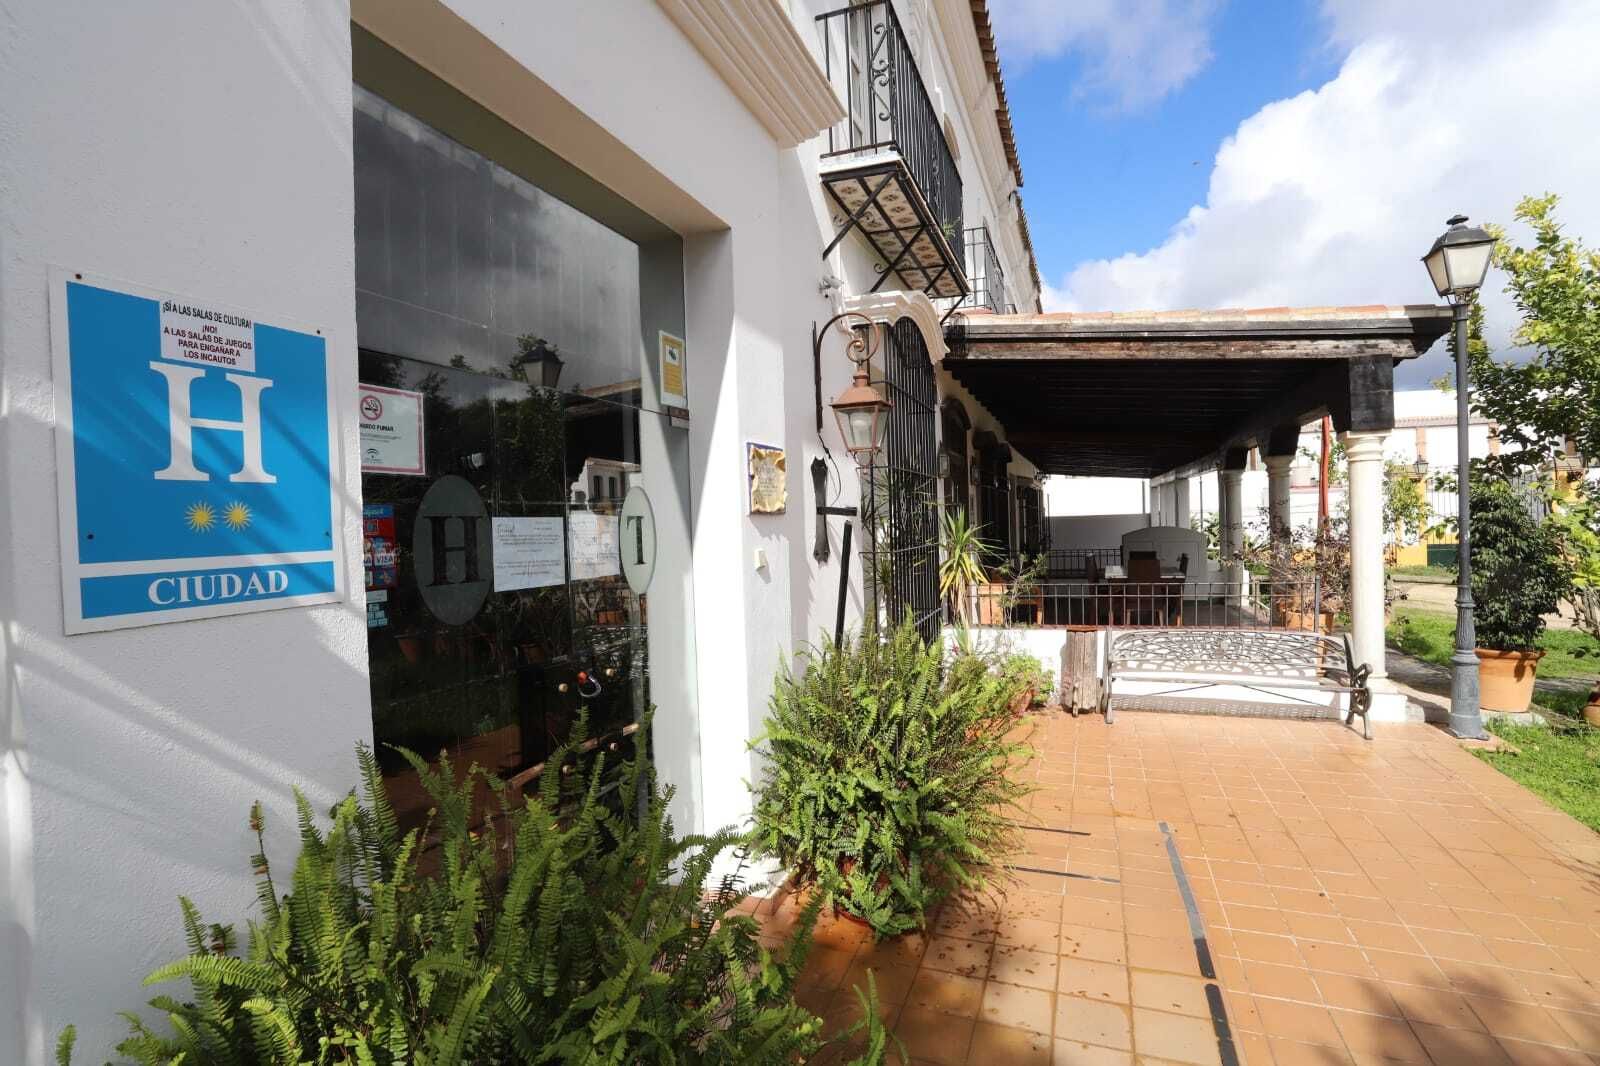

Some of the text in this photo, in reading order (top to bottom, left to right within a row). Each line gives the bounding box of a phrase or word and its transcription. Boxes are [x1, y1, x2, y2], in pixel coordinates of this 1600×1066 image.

[172, 304, 178, 314] A
[179, 304, 191, 316] LAS
[192, 307, 213, 321] SALAS
[214, 312, 222, 323] DE
[224, 314, 252, 329] CULTURA!
[164, 326, 252, 350] A LAS SALAS DE JUEGOS
[202, 324, 217, 334] ¡NO!
[178, 338, 198, 349] PARA
[235, 348, 241, 357] A
[184, 350, 237, 365] LOS INCAUTOS
[150, 361, 277, 483] H
[375, 554, 394, 565] VISA
[424, 514, 487, 588] H
[148, 569, 289, 605] CIUDAD
